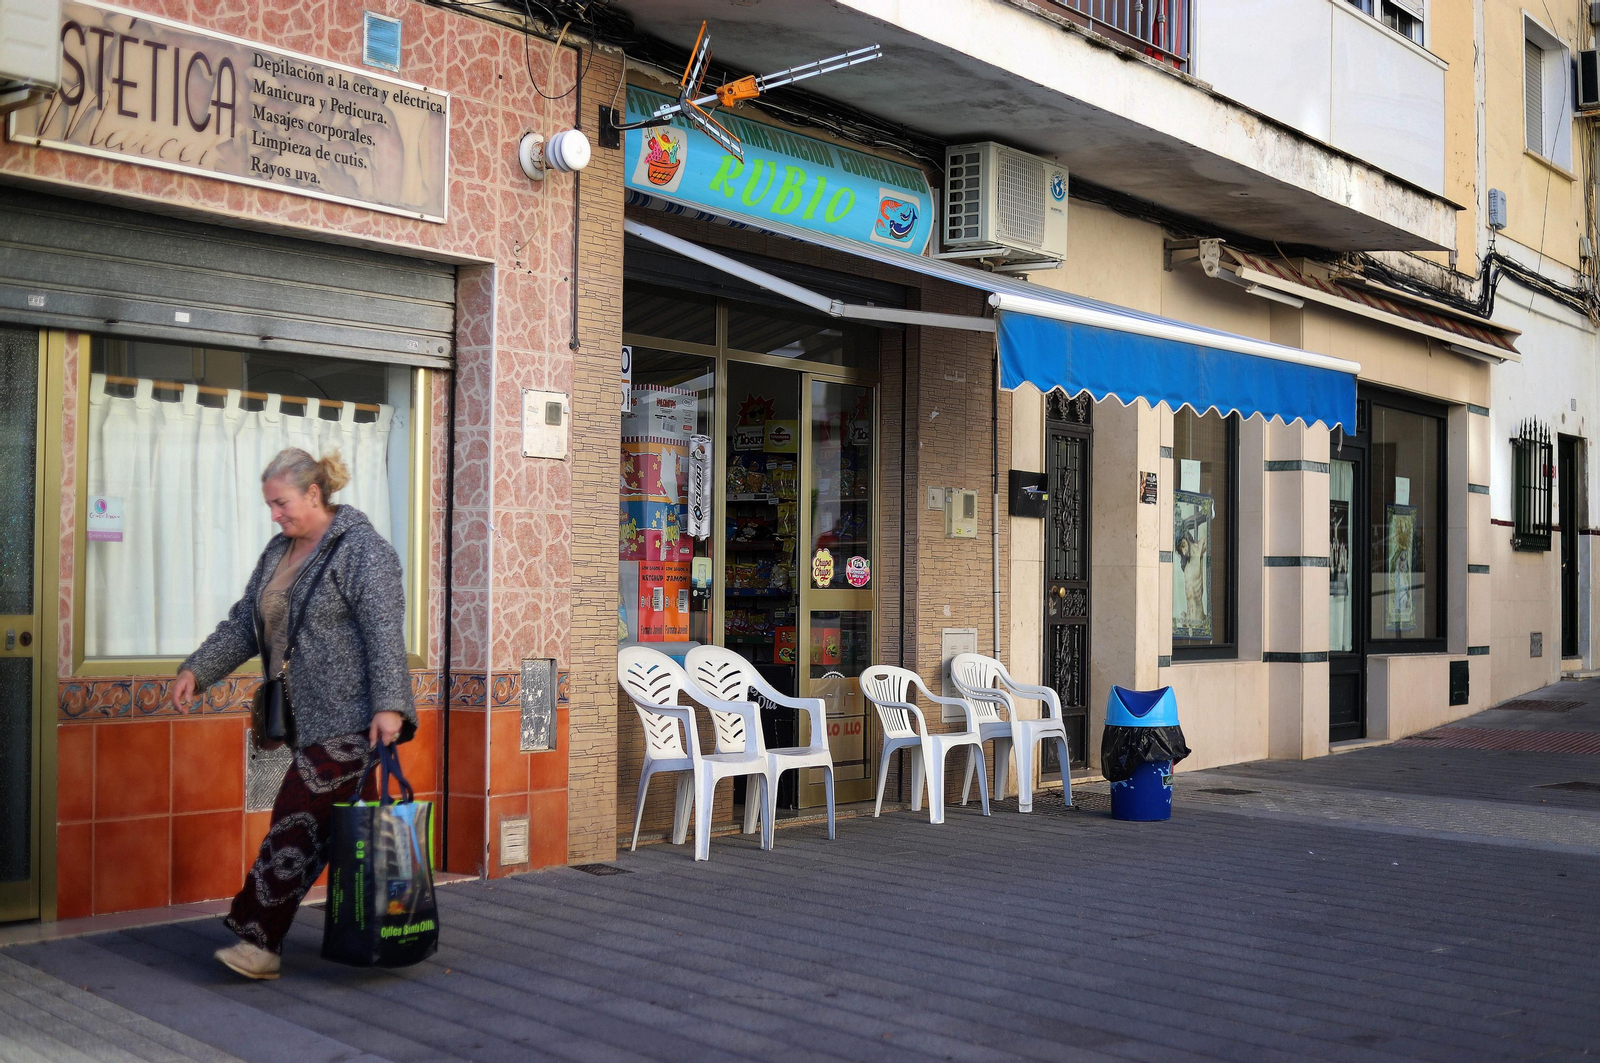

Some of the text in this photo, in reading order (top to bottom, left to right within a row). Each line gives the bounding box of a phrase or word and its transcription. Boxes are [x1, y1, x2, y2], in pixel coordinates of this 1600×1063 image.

[56, 17, 236, 138] STÉTICA
[253, 53, 446, 115] Depilación a la cera y eléctrica.
[253, 79, 387, 125] Manicura y Pedicura.
[252, 104, 376, 147] Masajes corporales.
[250, 156, 321, 184] Rayos uva.
[252, 130, 367, 169] Limpieza de cutis.
[839, 149, 927, 195] CONGELADOS
[708, 155, 856, 224] RUBIO
[815, 558, 832, 567] Chupa
